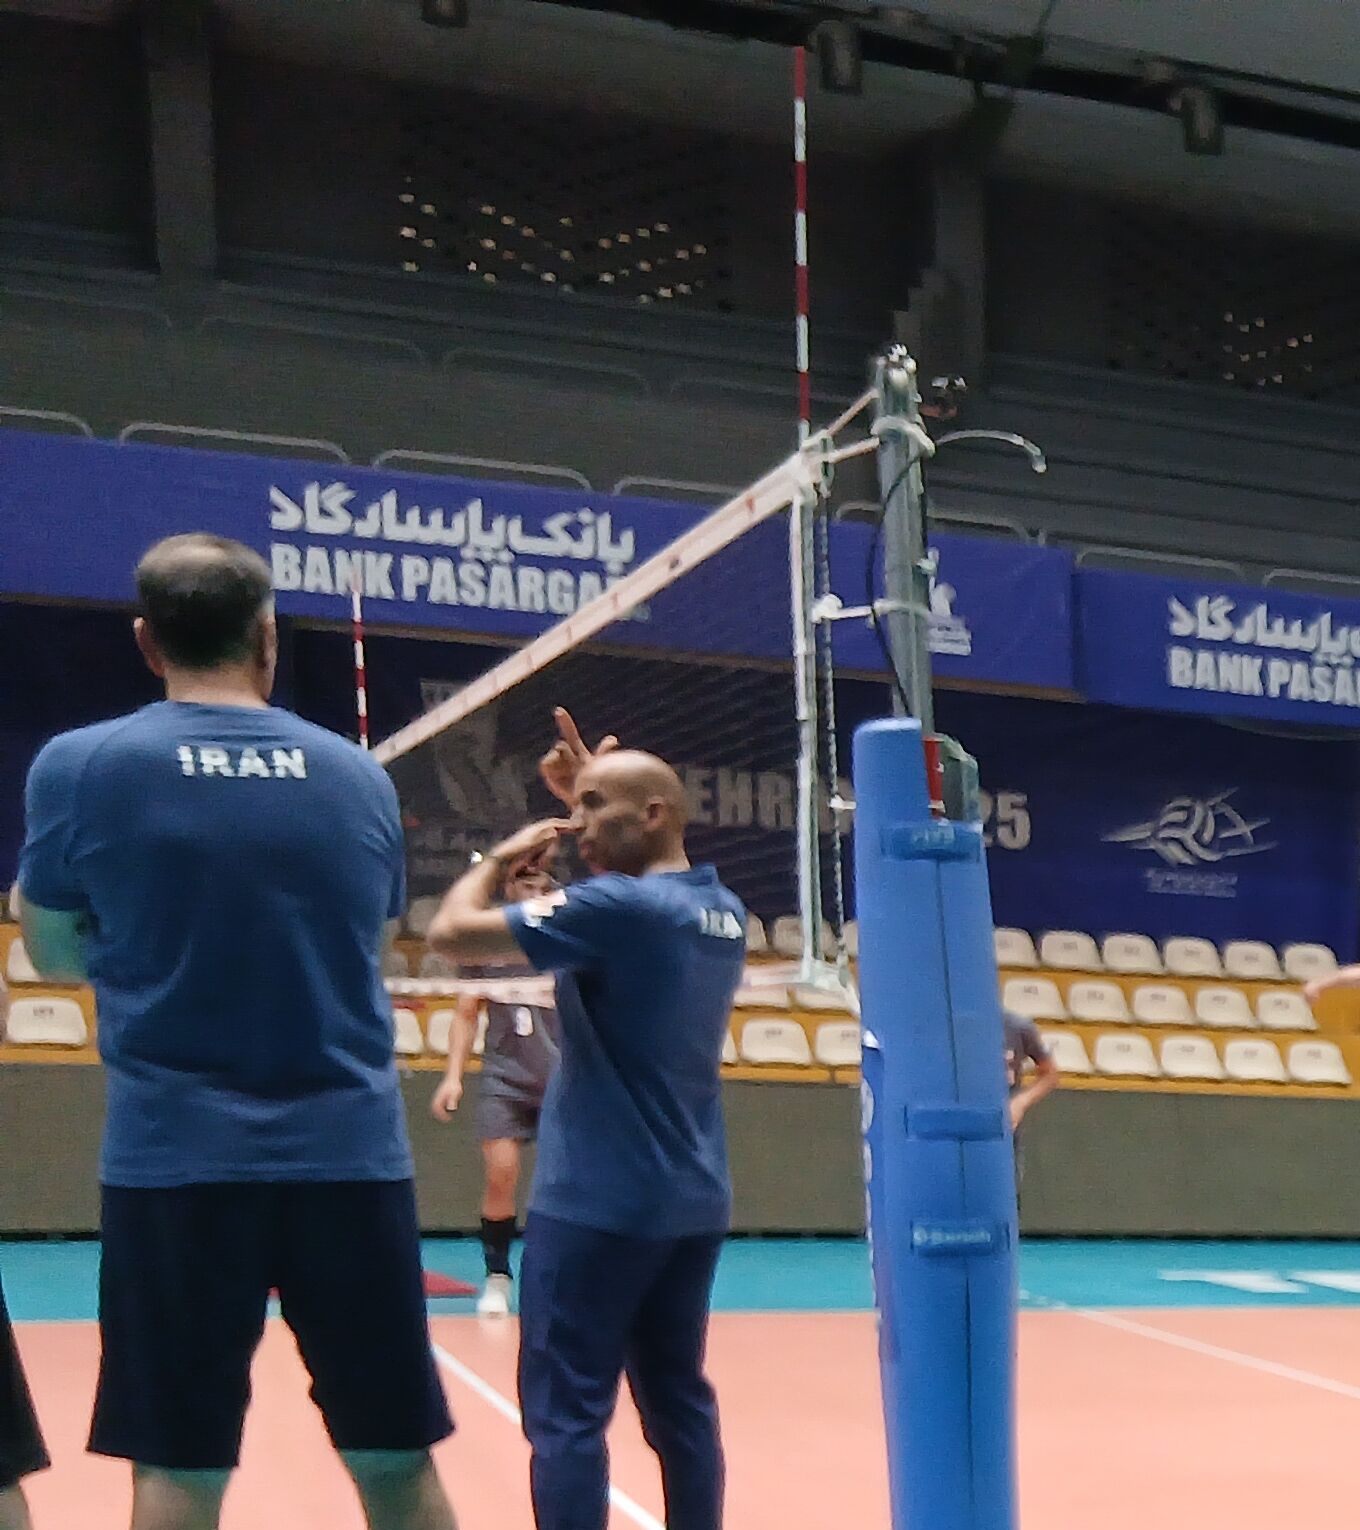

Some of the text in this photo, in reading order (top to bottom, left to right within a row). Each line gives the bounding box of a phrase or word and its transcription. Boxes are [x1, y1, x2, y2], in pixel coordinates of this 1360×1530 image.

[270, 542, 395, 600] BANK
[1168, 645, 1265, 697] BANK
[177, 744, 308, 781] IRAN
